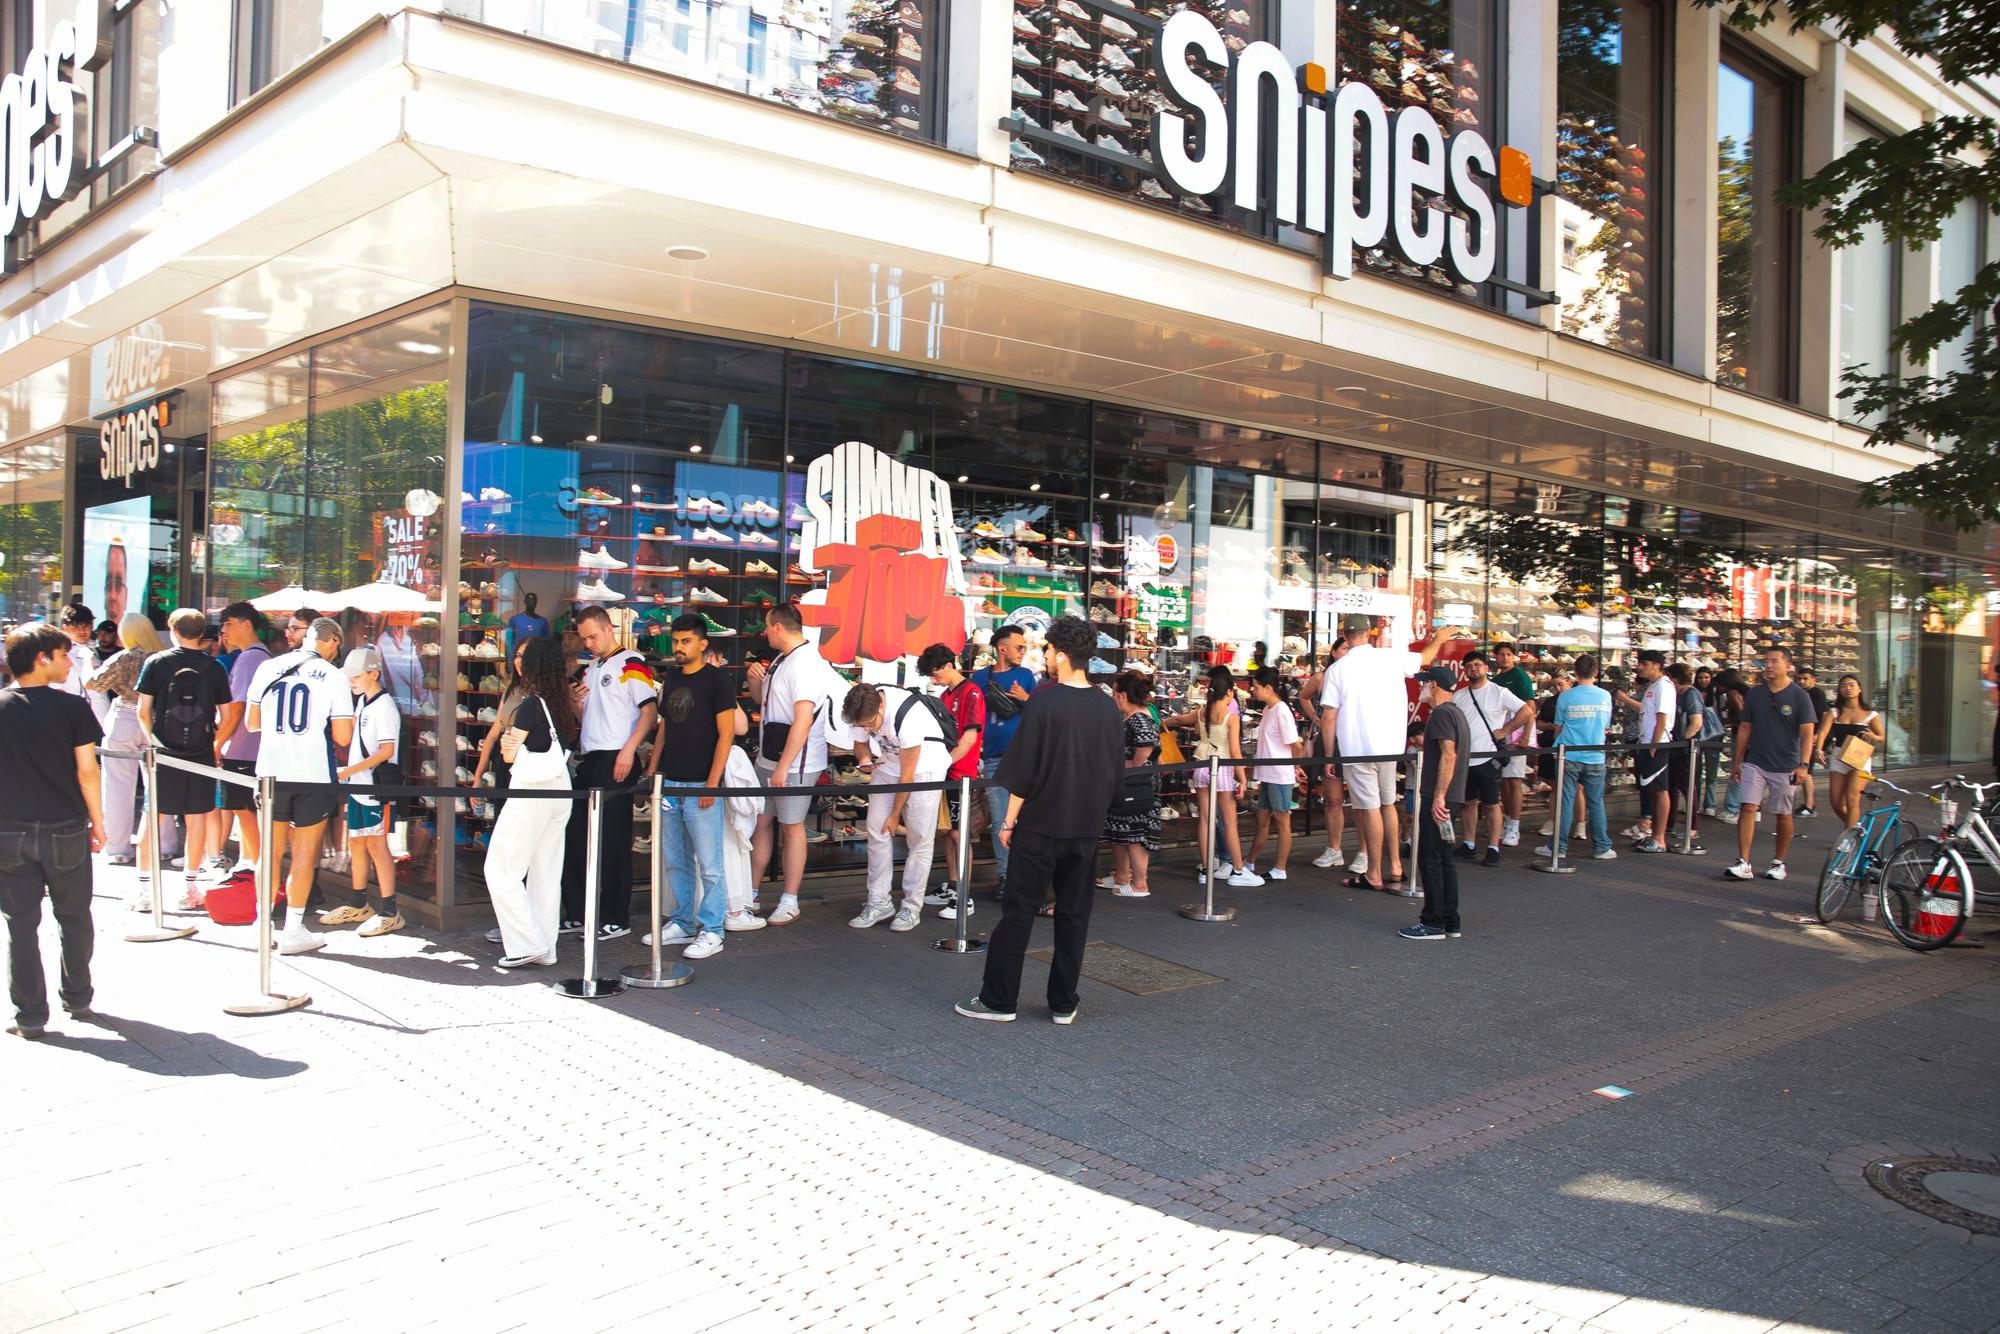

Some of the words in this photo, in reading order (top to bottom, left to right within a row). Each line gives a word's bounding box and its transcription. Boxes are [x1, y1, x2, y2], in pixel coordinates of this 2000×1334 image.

[1158, 9, 1497, 282] snipes
[101, 404, 159, 488] snipes
[387, 515, 424, 544] SALE
[798, 440, 968, 596] SUMMER
[271, 681, 311, 734] 10
